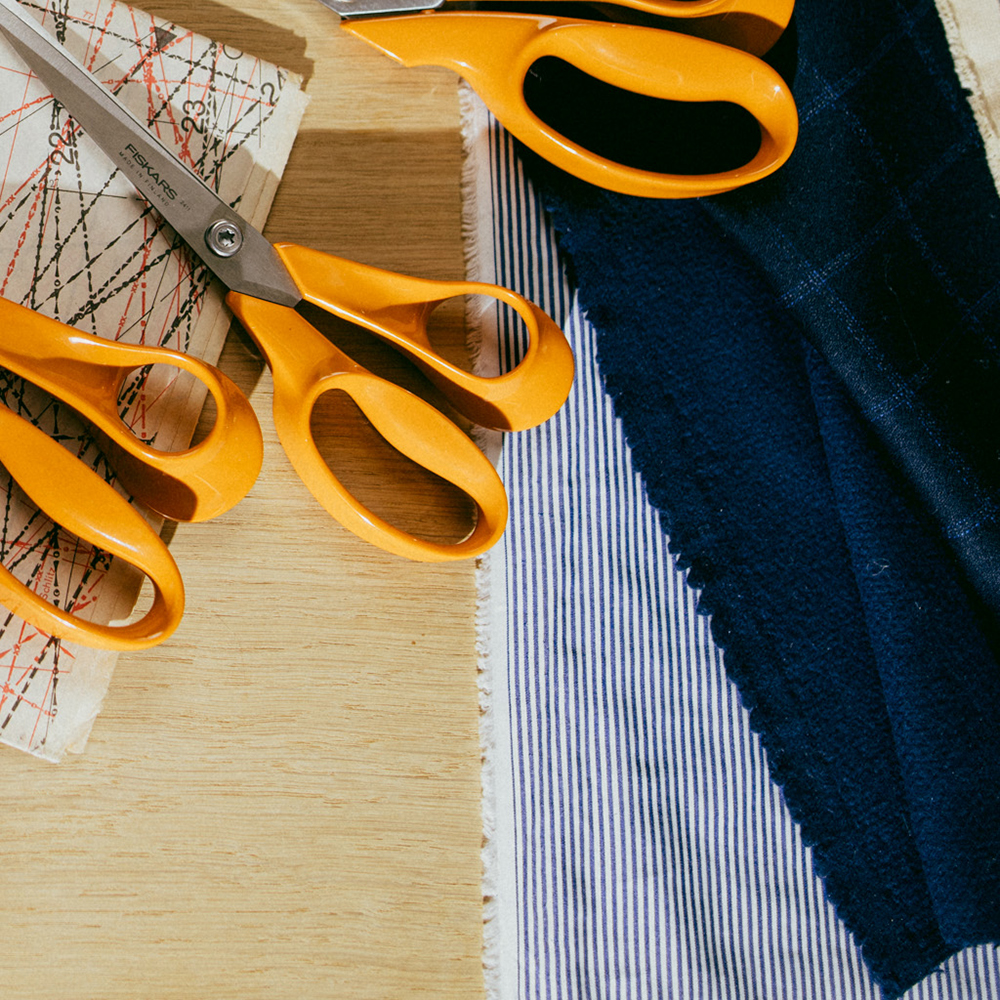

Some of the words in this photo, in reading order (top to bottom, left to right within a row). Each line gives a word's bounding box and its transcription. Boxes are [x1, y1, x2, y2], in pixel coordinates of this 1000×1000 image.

[181, 100, 206, 134] 23
[48, 131, 75, 165] 22
[118, 151, 136, 169] MADE
[135, 170, 143, 179] IN
[144, 179, 170, 207] FINLAND
[124, 143, 178, 200] FISKARS
